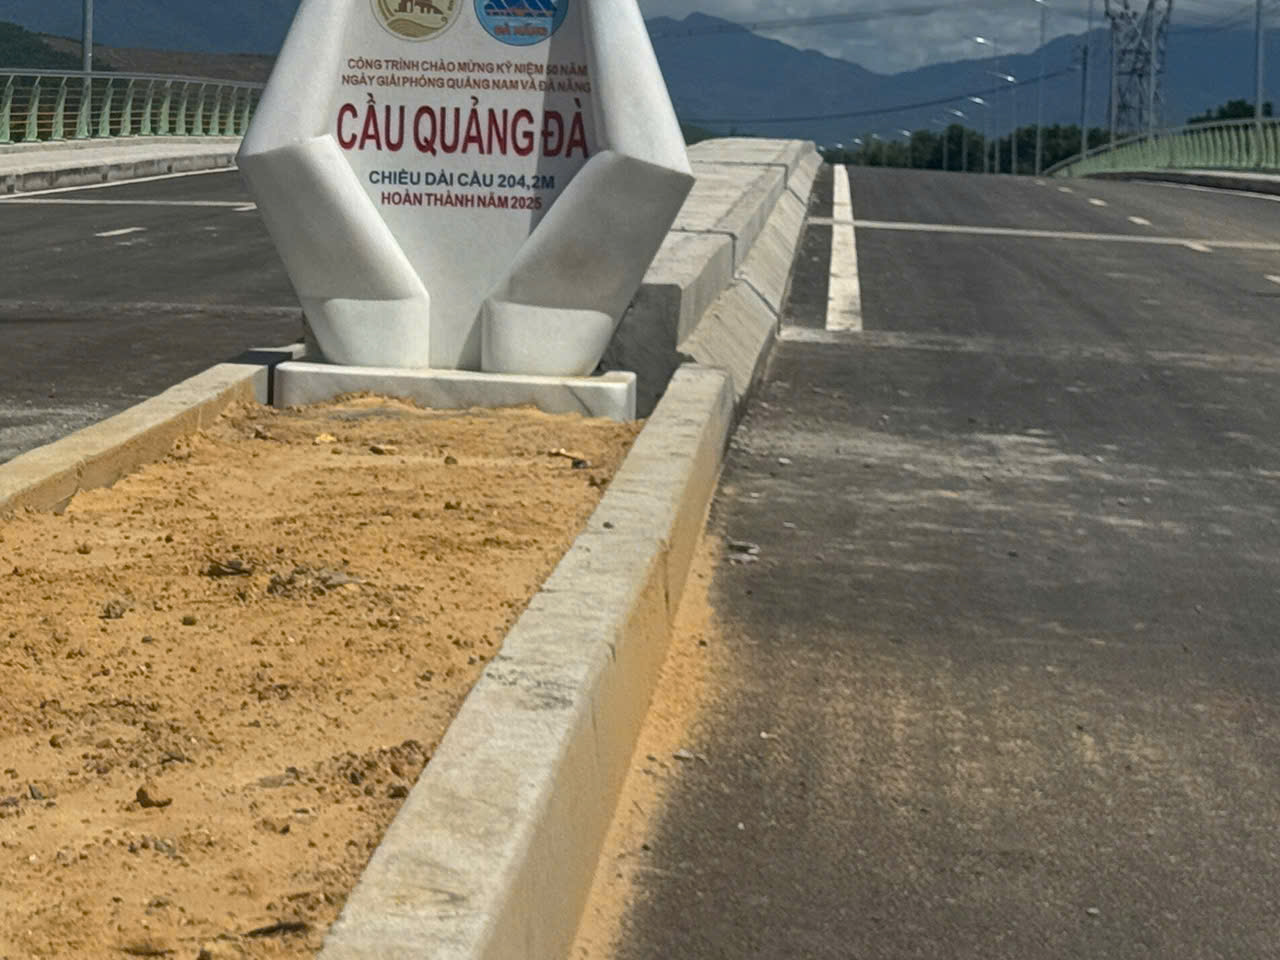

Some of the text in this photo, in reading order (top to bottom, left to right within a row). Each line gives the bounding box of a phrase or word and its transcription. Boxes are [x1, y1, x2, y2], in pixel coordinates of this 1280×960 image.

[348, 56, 382, 70] CÔNG
[384, 57, 419, 71] TRÌNH
[421, 58, 455, 72] CHÀO
[457, 59, 494, 73] MỪNG
[514, 61, 544, 75] NIỆM
[546, 65, 558, 75] 50
[560, 62, 588, 76] NĂM
[342, 72, 375, 86] NGÀY
[376, 73, 400, 87] GIẢI
[402, 74, 445, 88] PHÓNG
[446, 76, 490, 90] QUẢNG
[492, 79, 519, 90] NAM
[520, 76, 537, 91] VÀ
[538, 78, 555, 92] ĐÀ
[337, 92, 589, 158] CẦU QUẢNG ĐÀ
[369, 168, 554, 190] CHIỀU DÀI CẦU 204,2M
[381, 189, 542, 209] HOÀN THÀNH NĂM 2025
